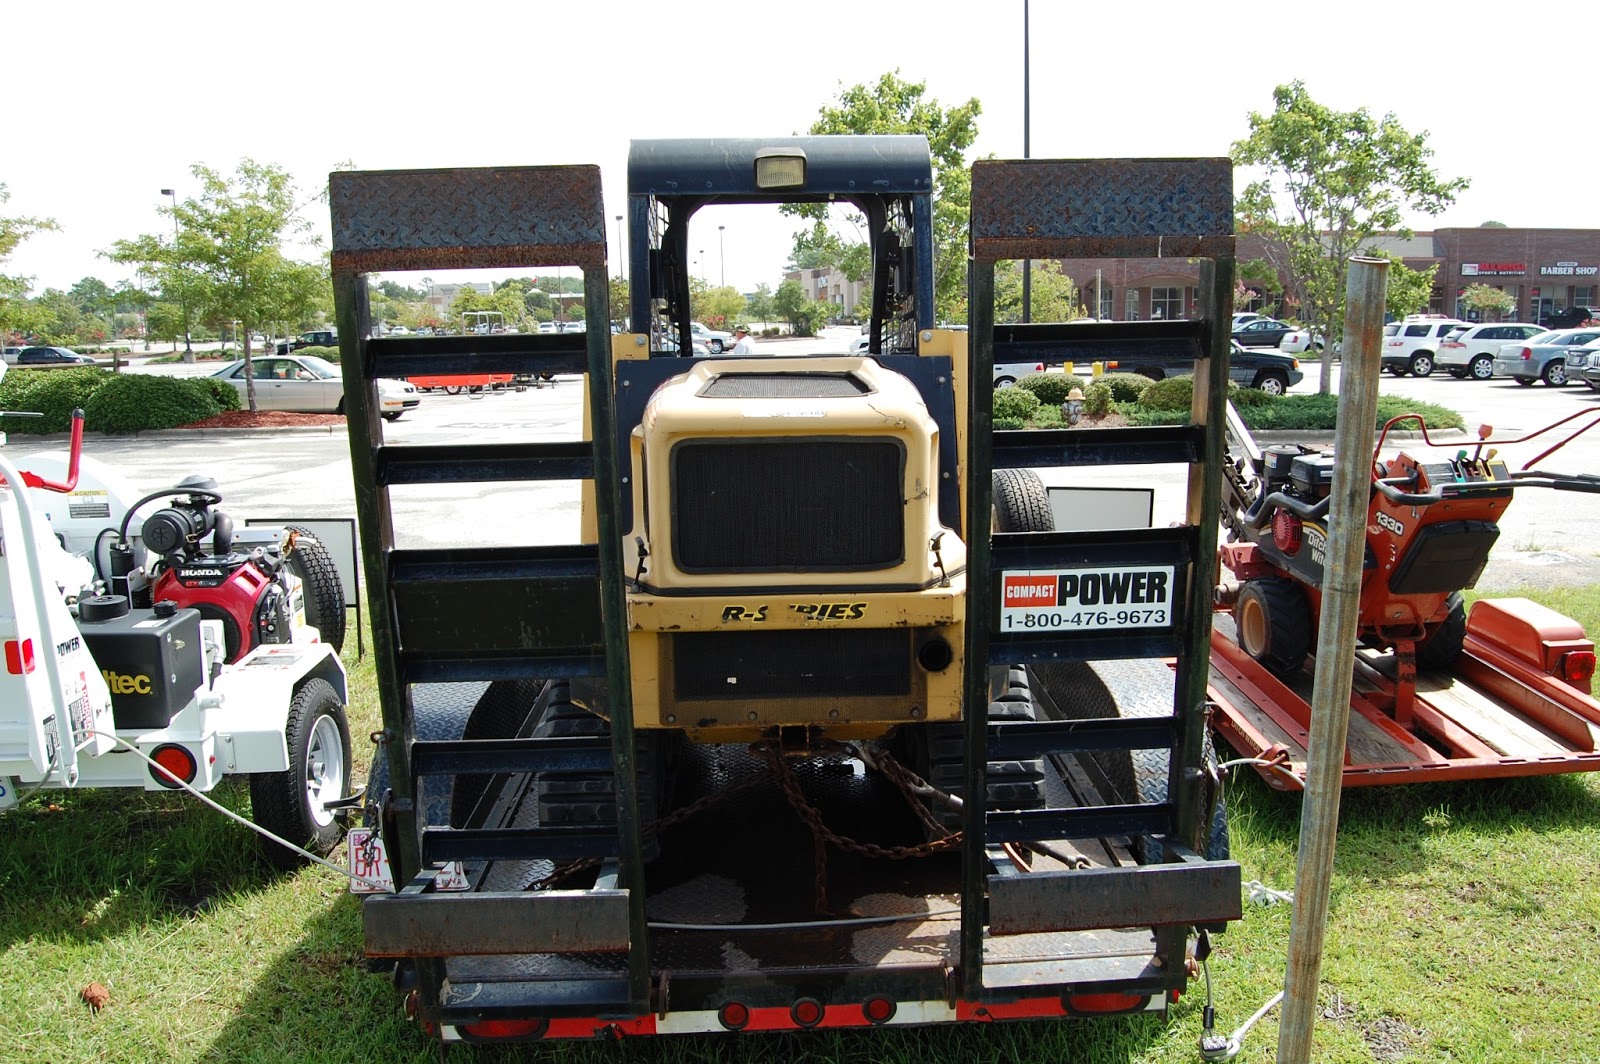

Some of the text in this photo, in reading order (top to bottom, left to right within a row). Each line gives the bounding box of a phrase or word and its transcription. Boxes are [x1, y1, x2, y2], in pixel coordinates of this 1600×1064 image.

[1541, 267, 1597, 275] BARBER SHOP
[1375, 511, 1404, 536] 1330
[180, 569, 223, 577] HONDA
[1006, 571, 1168, 607] COMPACT POWER
[722, 603, 869, 622] R-SRIES
[1004, 609, 1166, 629] 1-800-476-9673
